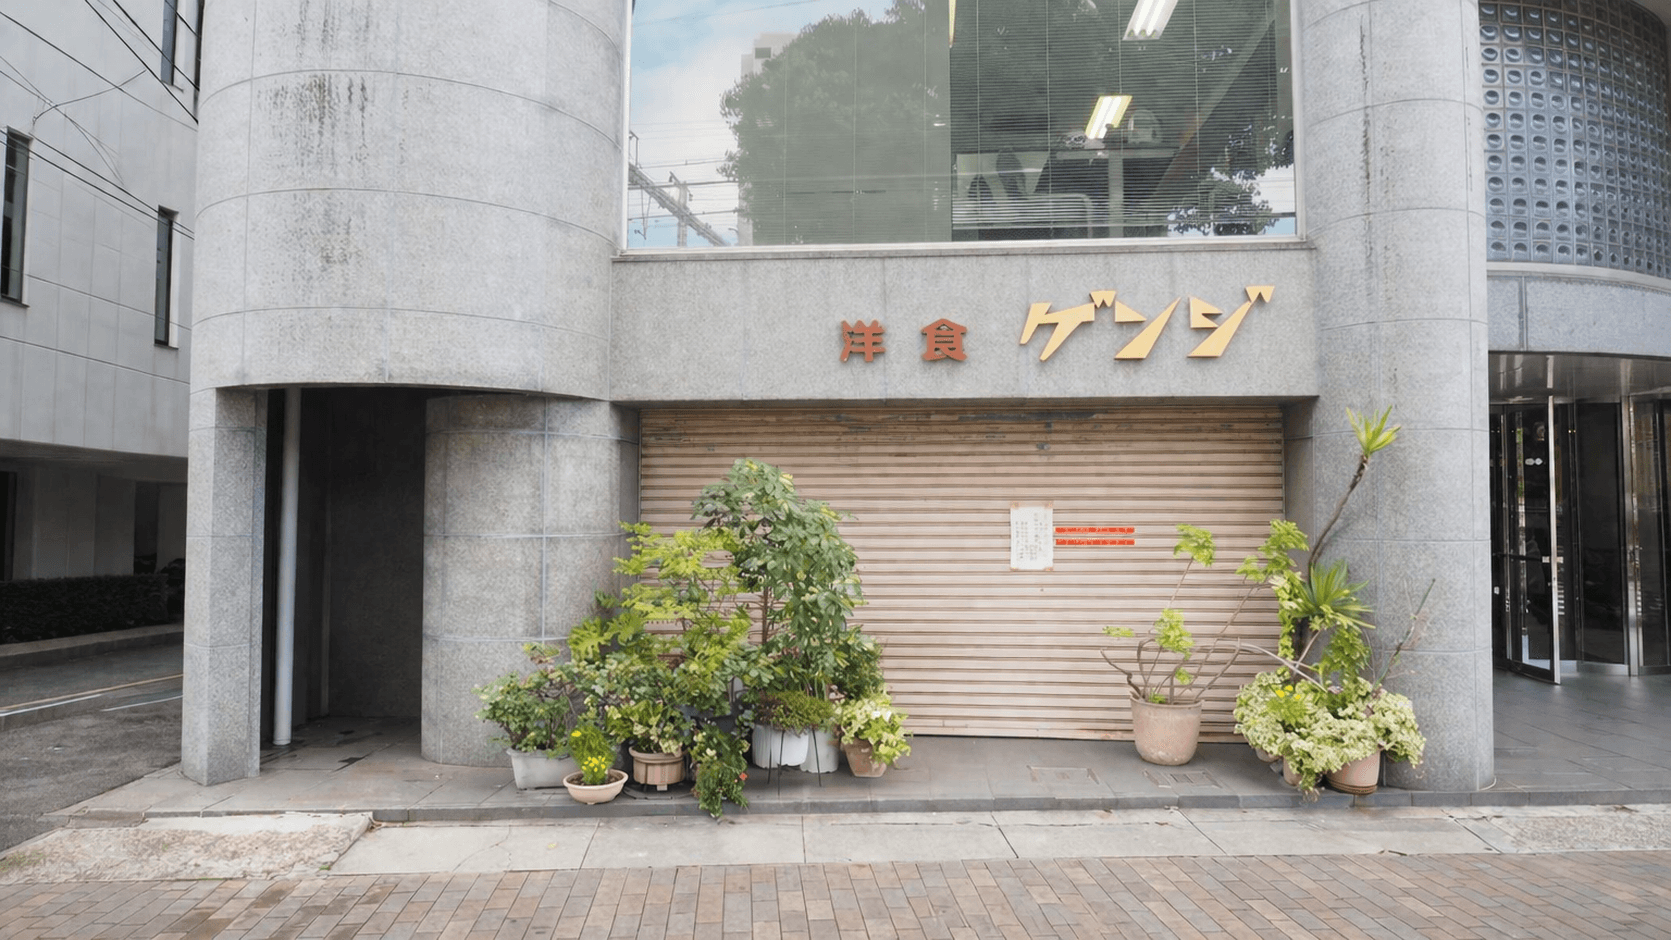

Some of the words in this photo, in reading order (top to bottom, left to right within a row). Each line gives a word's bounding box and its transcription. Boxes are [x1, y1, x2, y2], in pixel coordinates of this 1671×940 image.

[841, 318, 968, 362] 洋食
[1019, 286, 1275, 361] ゲンジ
